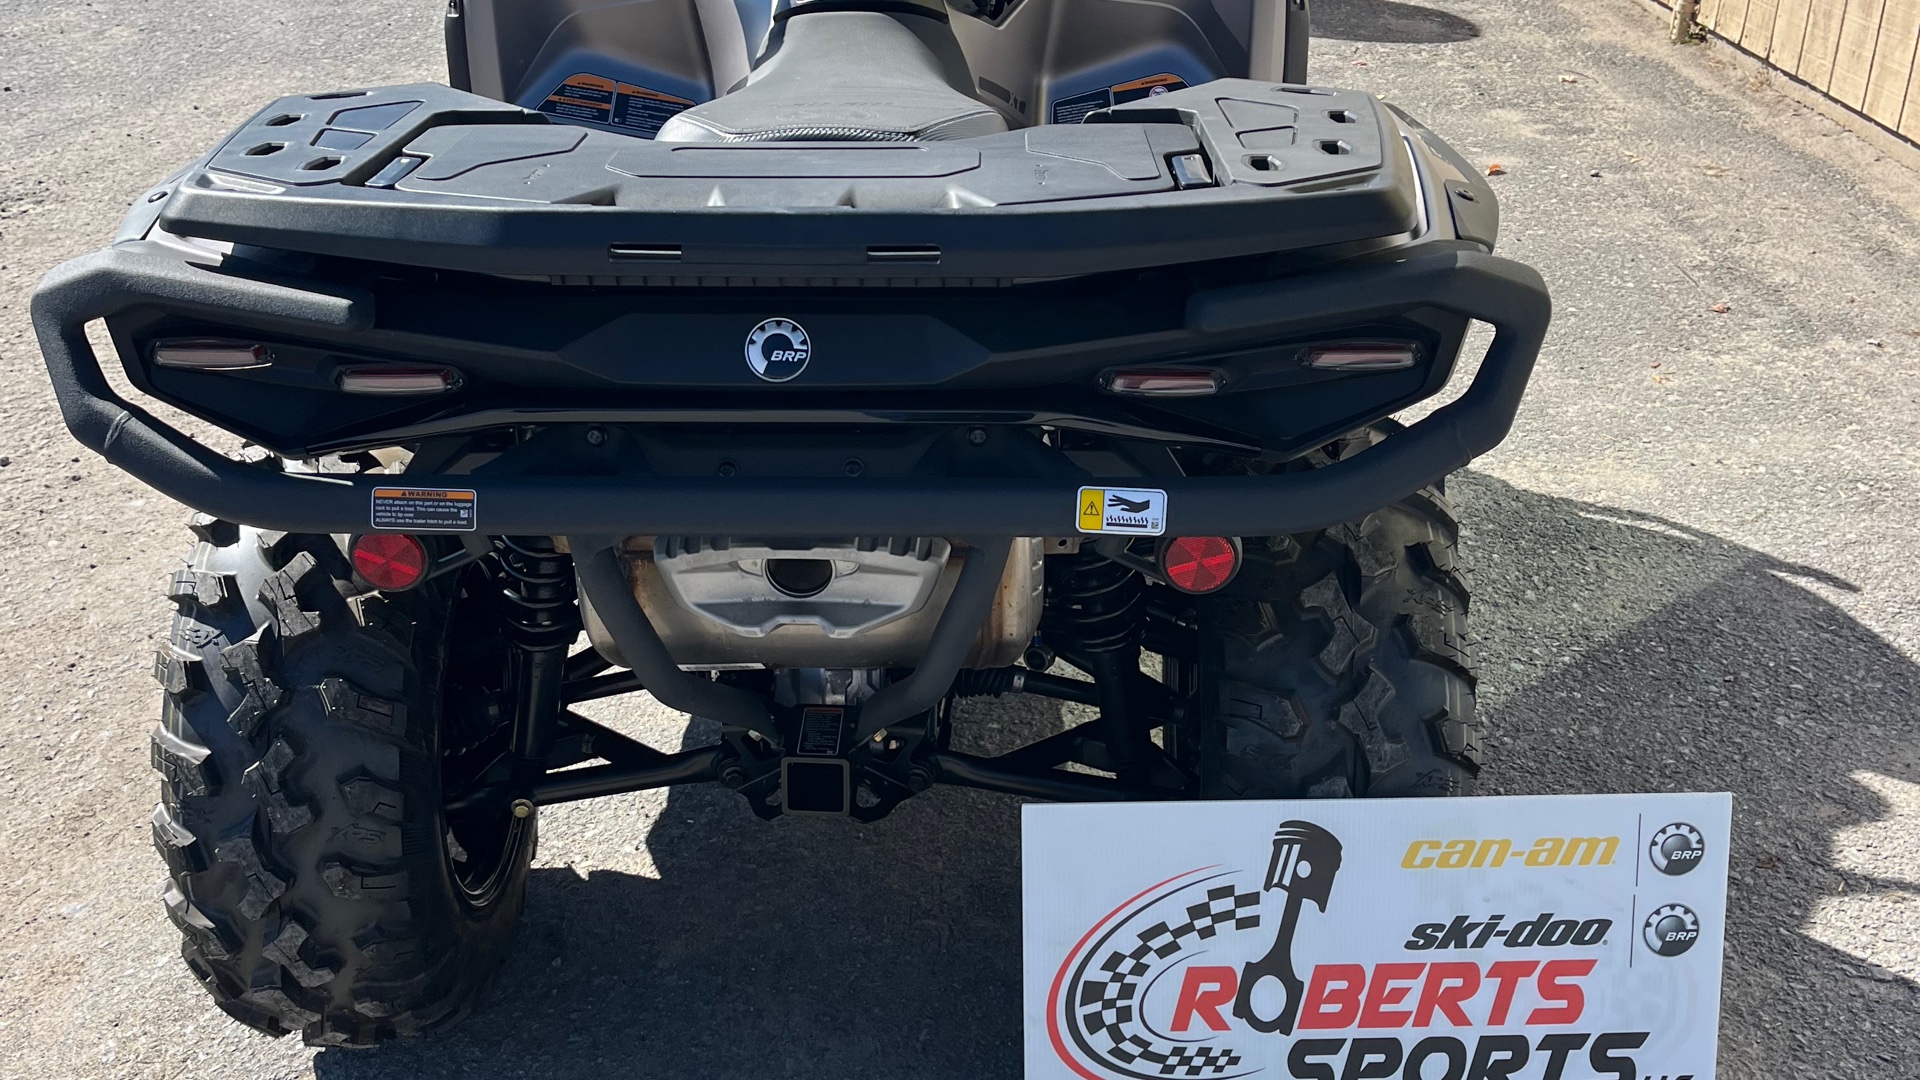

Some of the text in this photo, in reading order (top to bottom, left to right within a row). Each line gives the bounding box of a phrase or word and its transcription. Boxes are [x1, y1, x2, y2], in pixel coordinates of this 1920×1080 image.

[770, 350, 807, 362] BRP
[1400, 836, 1620, 869] can-am
[1670, 850, 1702, 860] BRP
[1665, 931, 1698, 942] BRP
[1171, 959, 1598, 1036] ROBERTS
[1287, 1032, 1651, 1080] SPORTS
